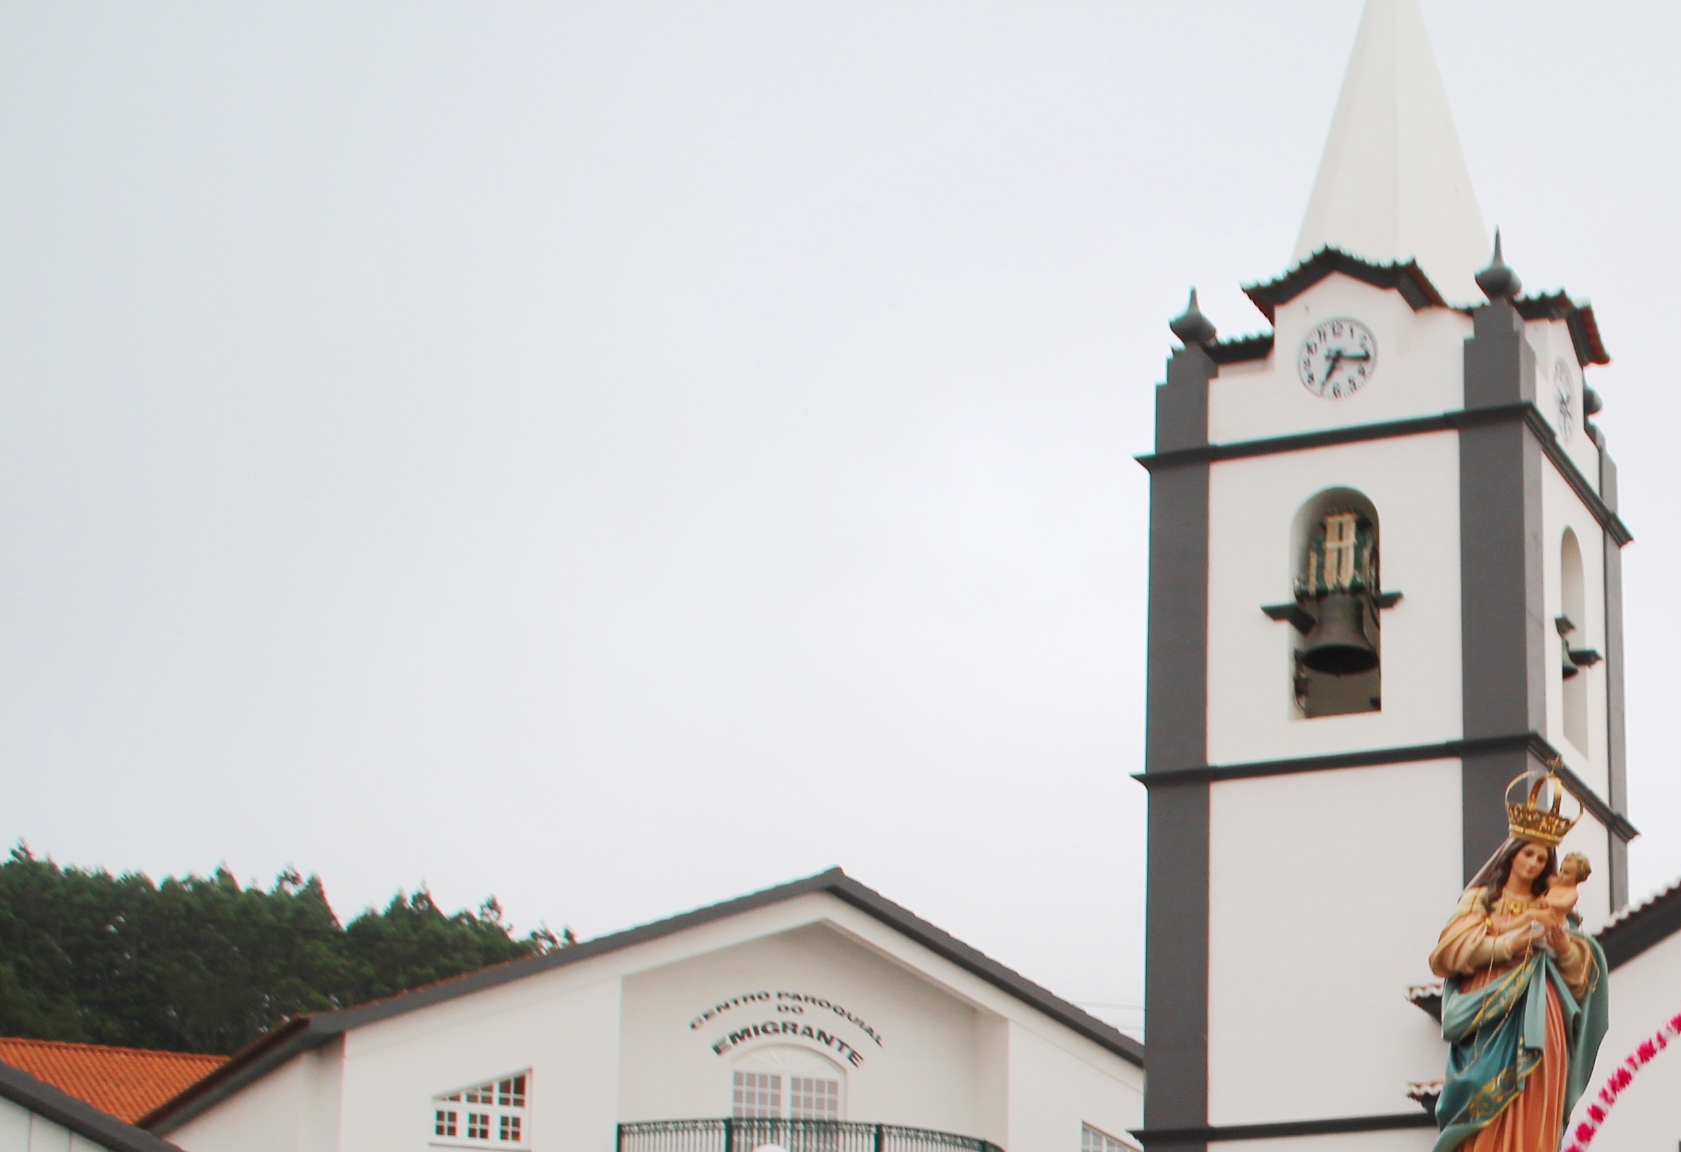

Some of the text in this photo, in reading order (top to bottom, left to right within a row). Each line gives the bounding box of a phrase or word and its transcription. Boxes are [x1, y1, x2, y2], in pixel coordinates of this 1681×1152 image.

[689, 991, 884, 1048] CENTRO PAROQUIAL
[777, 1004, 804, 1015] DO
[711, 1020, 864, 1069] EMIGRANTE
